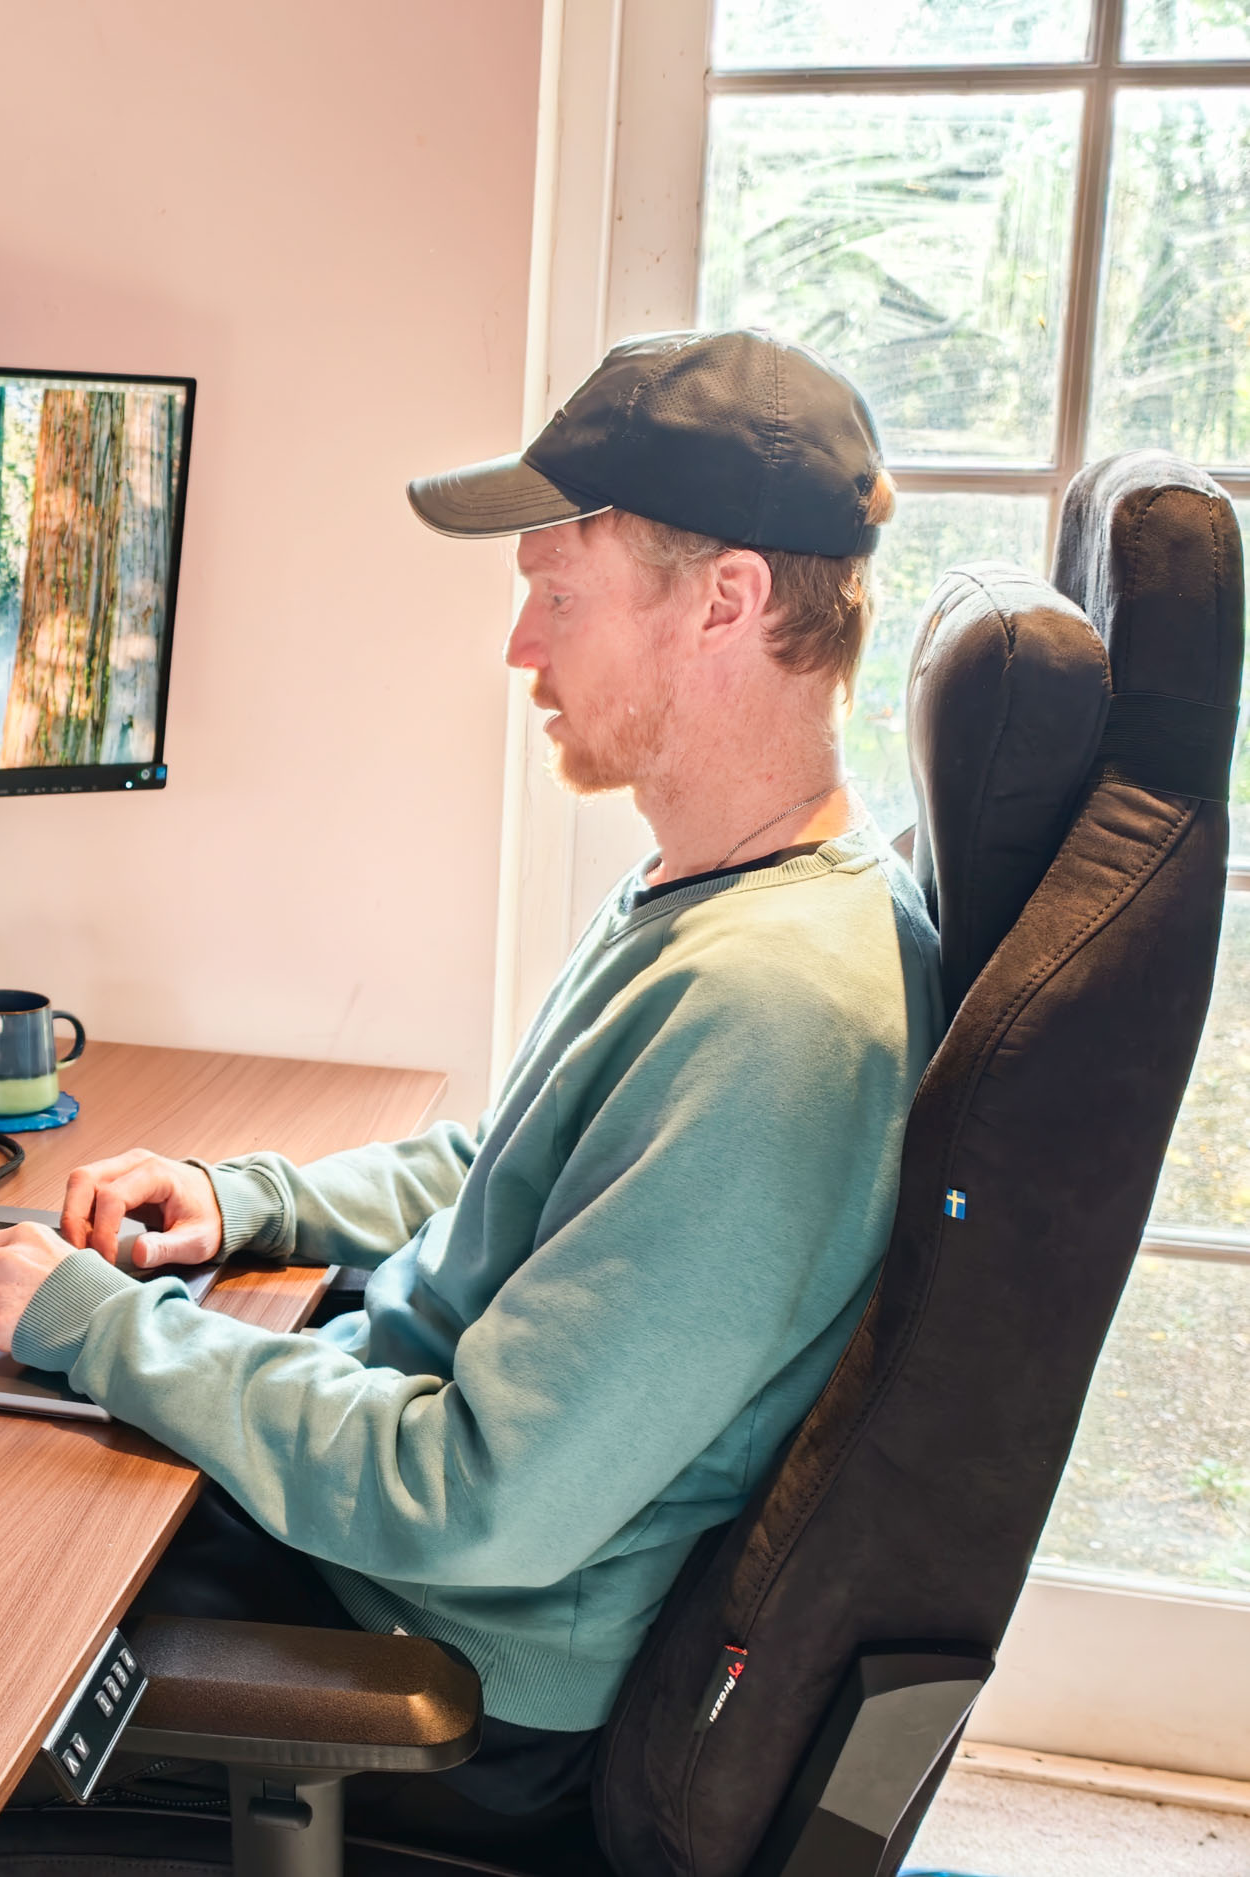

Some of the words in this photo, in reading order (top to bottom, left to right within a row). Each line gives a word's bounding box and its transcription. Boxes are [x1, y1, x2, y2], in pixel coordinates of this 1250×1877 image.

[100, 1698, 111, 1712] 1
[108, 1681, 119, 1698] 2
[116, 1668, 127, 1683] 3
[124, 1652, 135, 1667] 4
[709, 1675, 736, 1722] Arozzi
